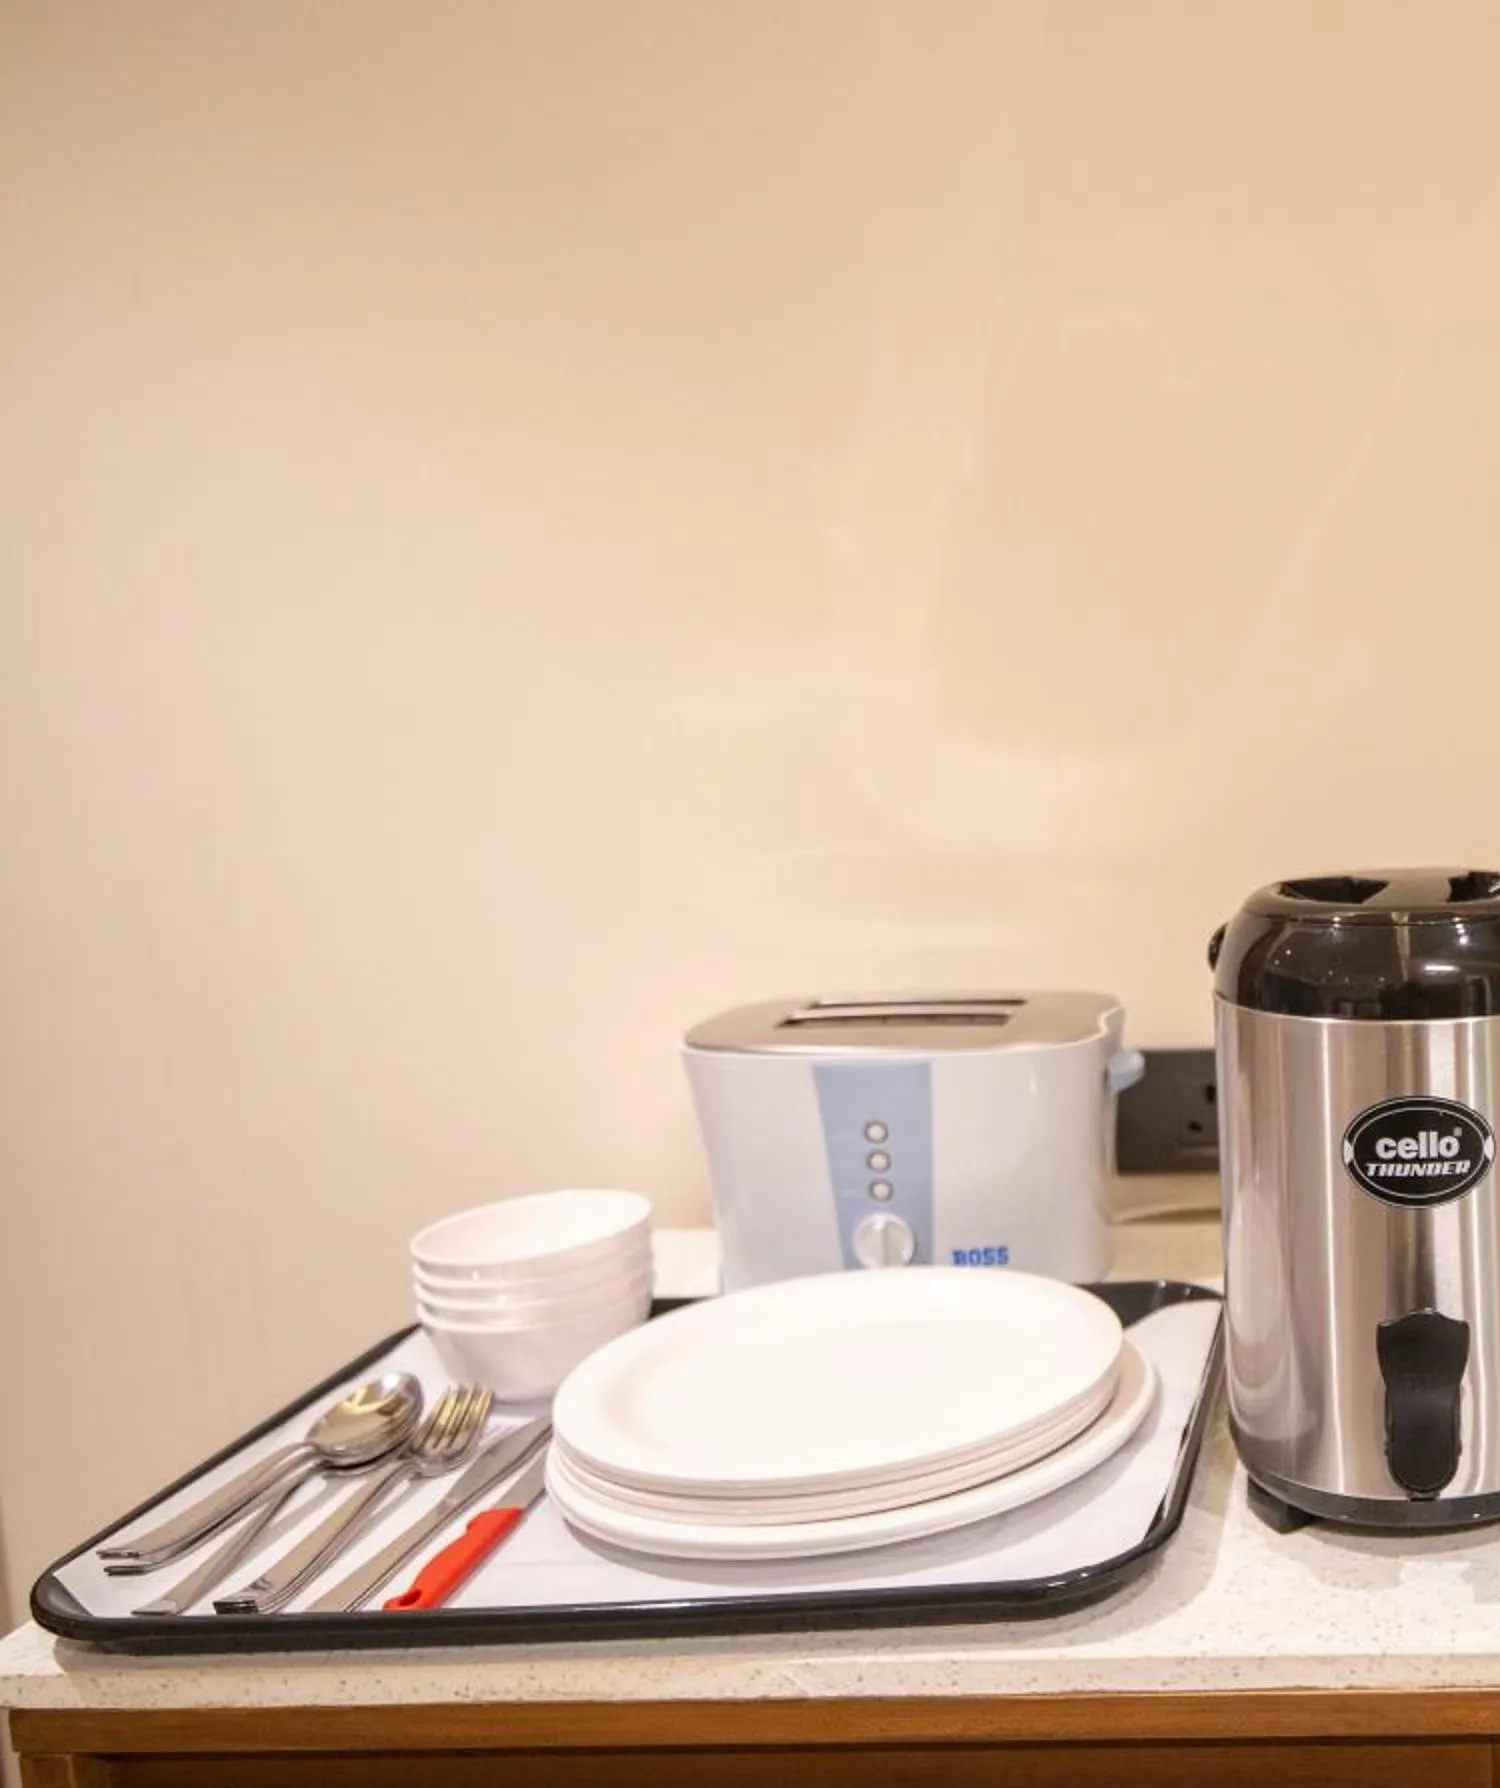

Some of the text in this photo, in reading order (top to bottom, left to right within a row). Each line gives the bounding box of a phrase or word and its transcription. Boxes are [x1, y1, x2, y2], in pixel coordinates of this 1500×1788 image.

[1375, 1131, 1460, 1159] cello
[1365, 1160, 1471, 1177] THUNDER
[952, 1247, 1009, 1266] BOSS
